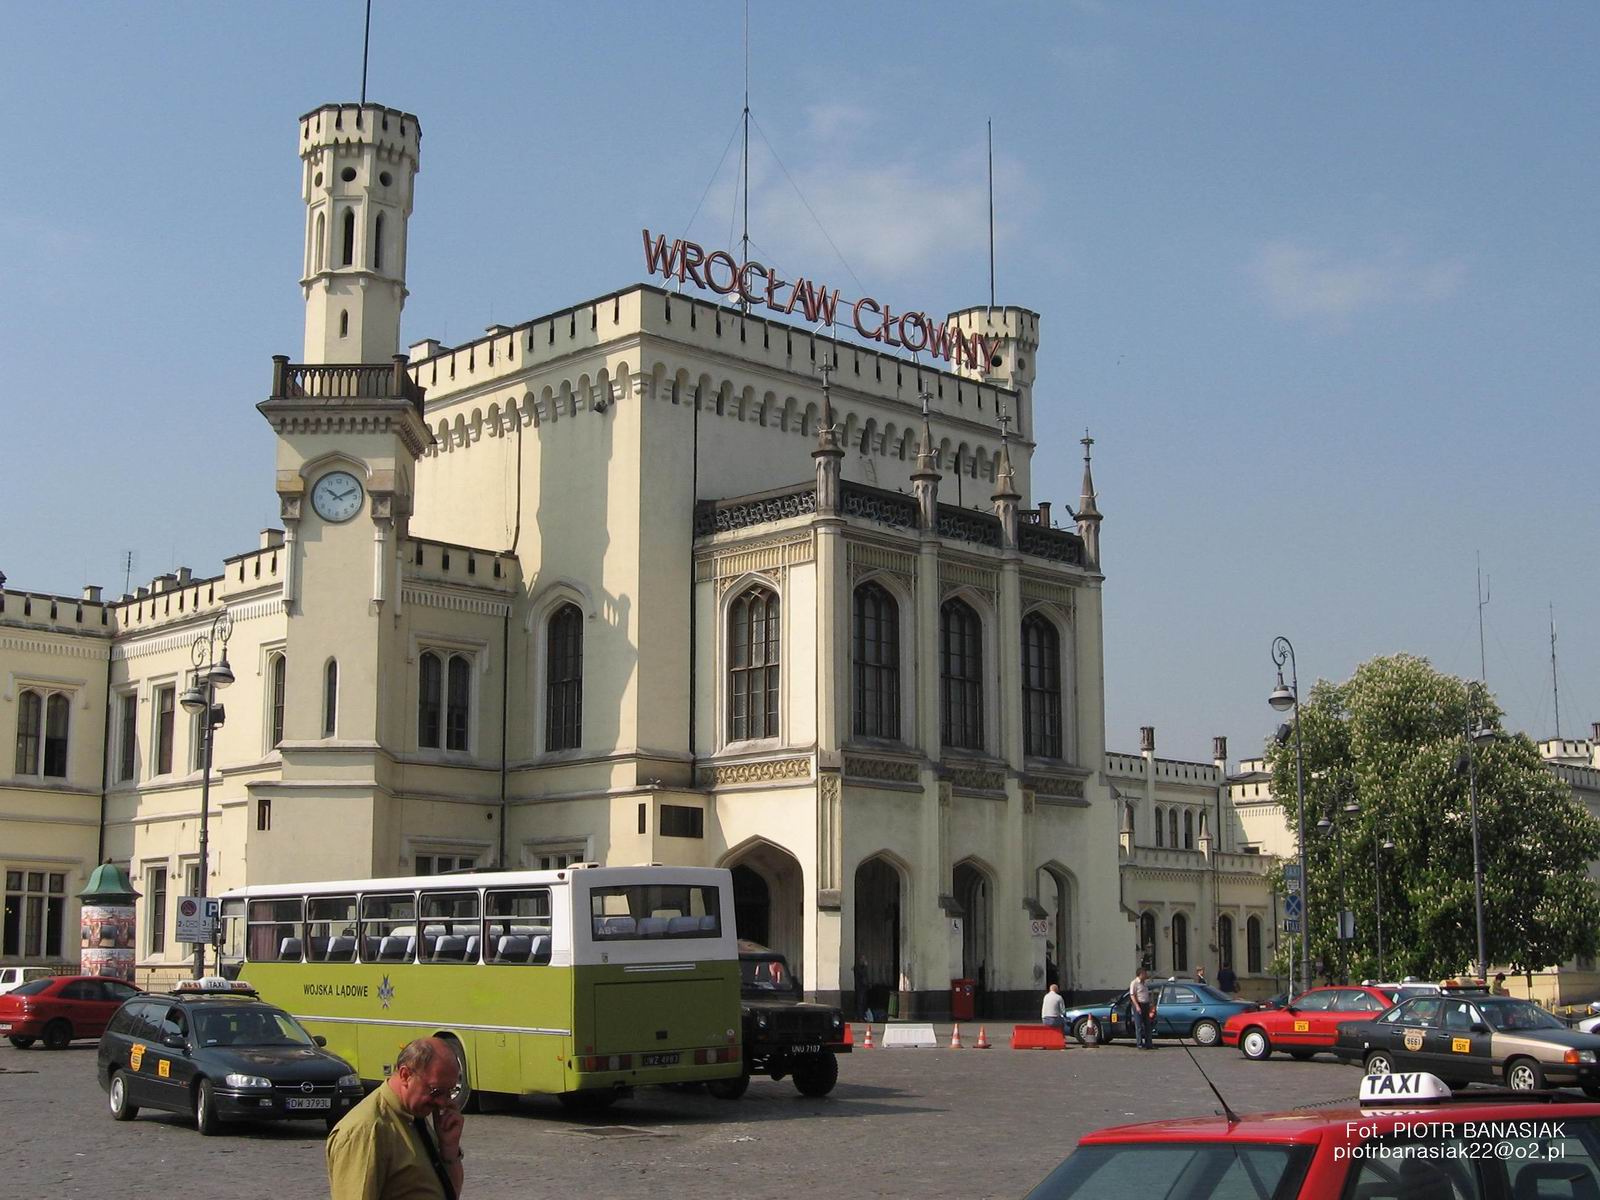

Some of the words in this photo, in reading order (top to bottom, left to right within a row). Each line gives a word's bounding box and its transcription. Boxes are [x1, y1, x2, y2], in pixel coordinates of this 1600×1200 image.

[642, 229, 840, 327] WROCŁAW
[208, 981, 224, 989] TAXI
[303, 984, 333, 996] WOJSKA
[1367, 1074, 1421, 1095] TAXI
